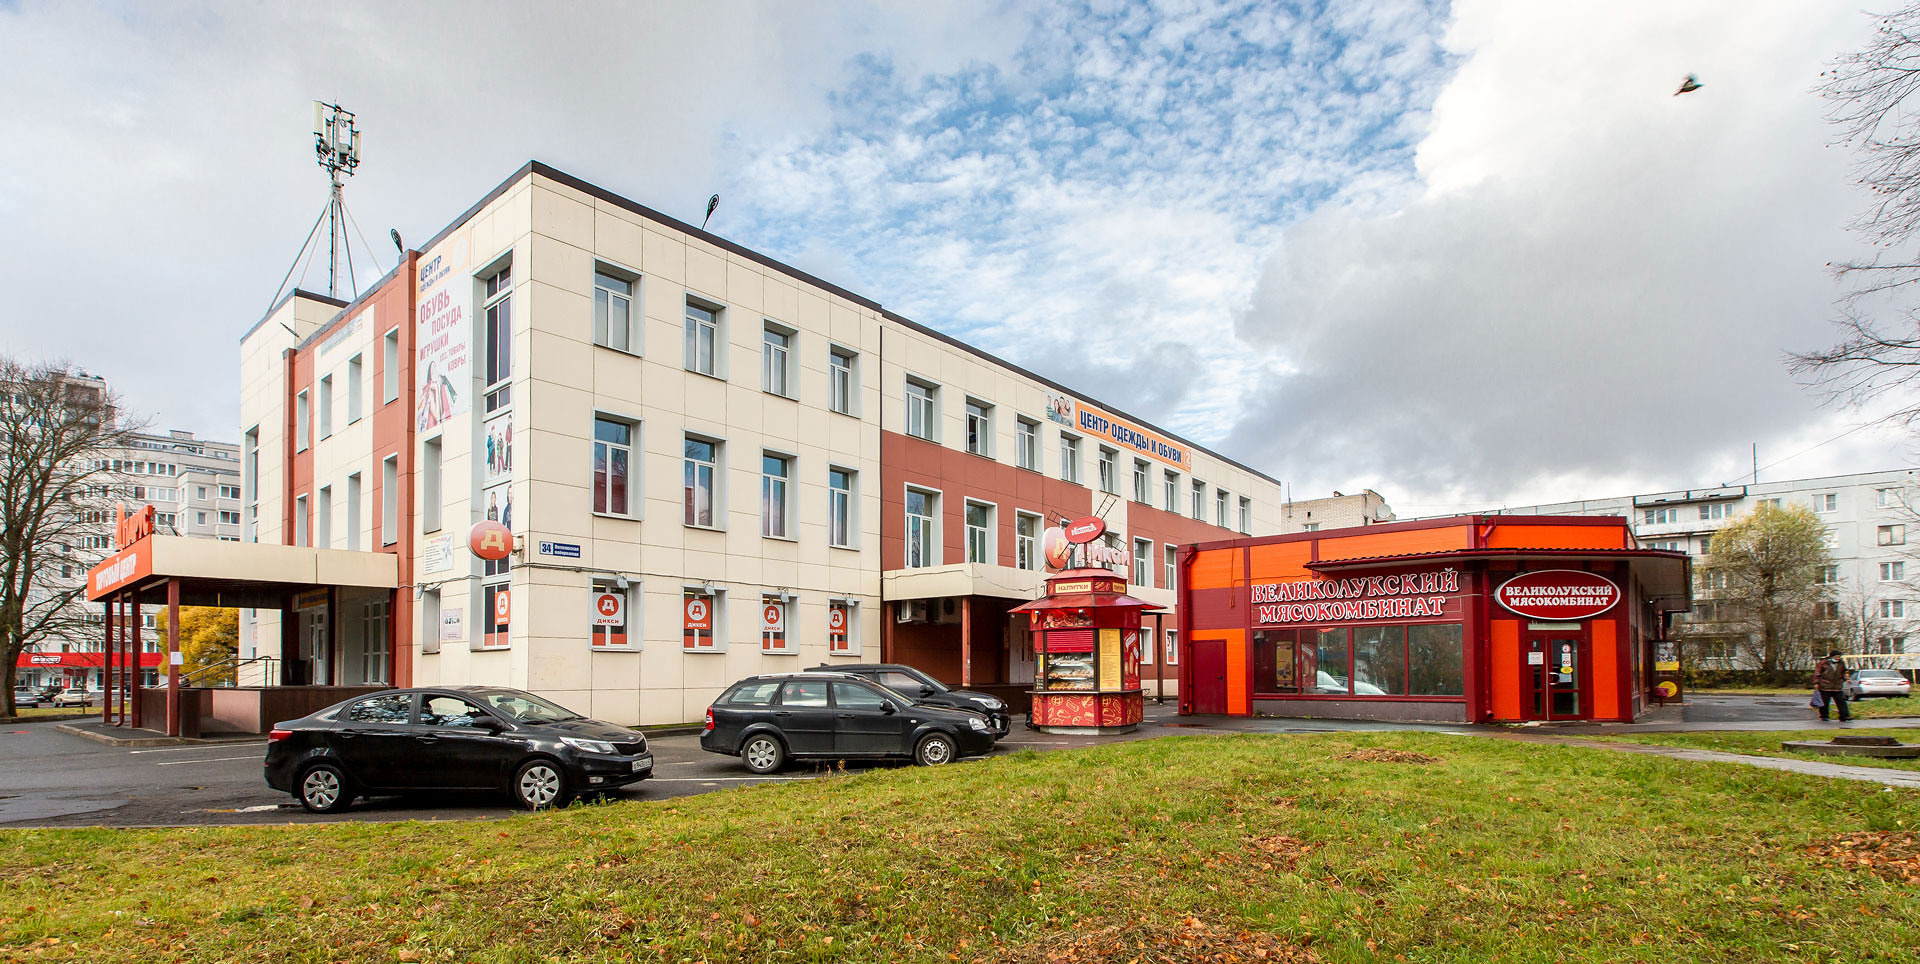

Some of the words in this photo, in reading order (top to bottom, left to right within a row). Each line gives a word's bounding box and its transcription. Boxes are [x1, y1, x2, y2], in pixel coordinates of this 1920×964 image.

[420, 254, 442, 283] ЦЕНТР
[420, 289, 450, 325] ОБУВЬ
[432, 305, 462, 336] ПОСУДА
[420, 332, 449, 361] ИГРУШКИ
[448, 354, 466, 372] КОВРЫ
[1080, 410, 1109, 434] ЦЕНТР
[1111, 423, 1149, 450] ОДЕЖДЫ
[1151, 440, 1156, 454] И
[1158, 442, 1181, 464] ОБУВИ
[481, 530, 505, 552] Д
[542, 543, 551, 553] 34
[1251, 567, 1459, 604] ВЕЛИКОЛУКСКИЙ
[1505, 585, 1612, 596] ВЕЛИКОЛУКСКИЙ
[602, 600, 614, 612] Д
[692, 605, 702, 616] Д
[1259, 596, 1446, 624] МЯСОКОМБИНАТ
[1510, 597, 1608, 606] МЯСОКОМБИНАТ
[767, 609, 777, 620] Д
